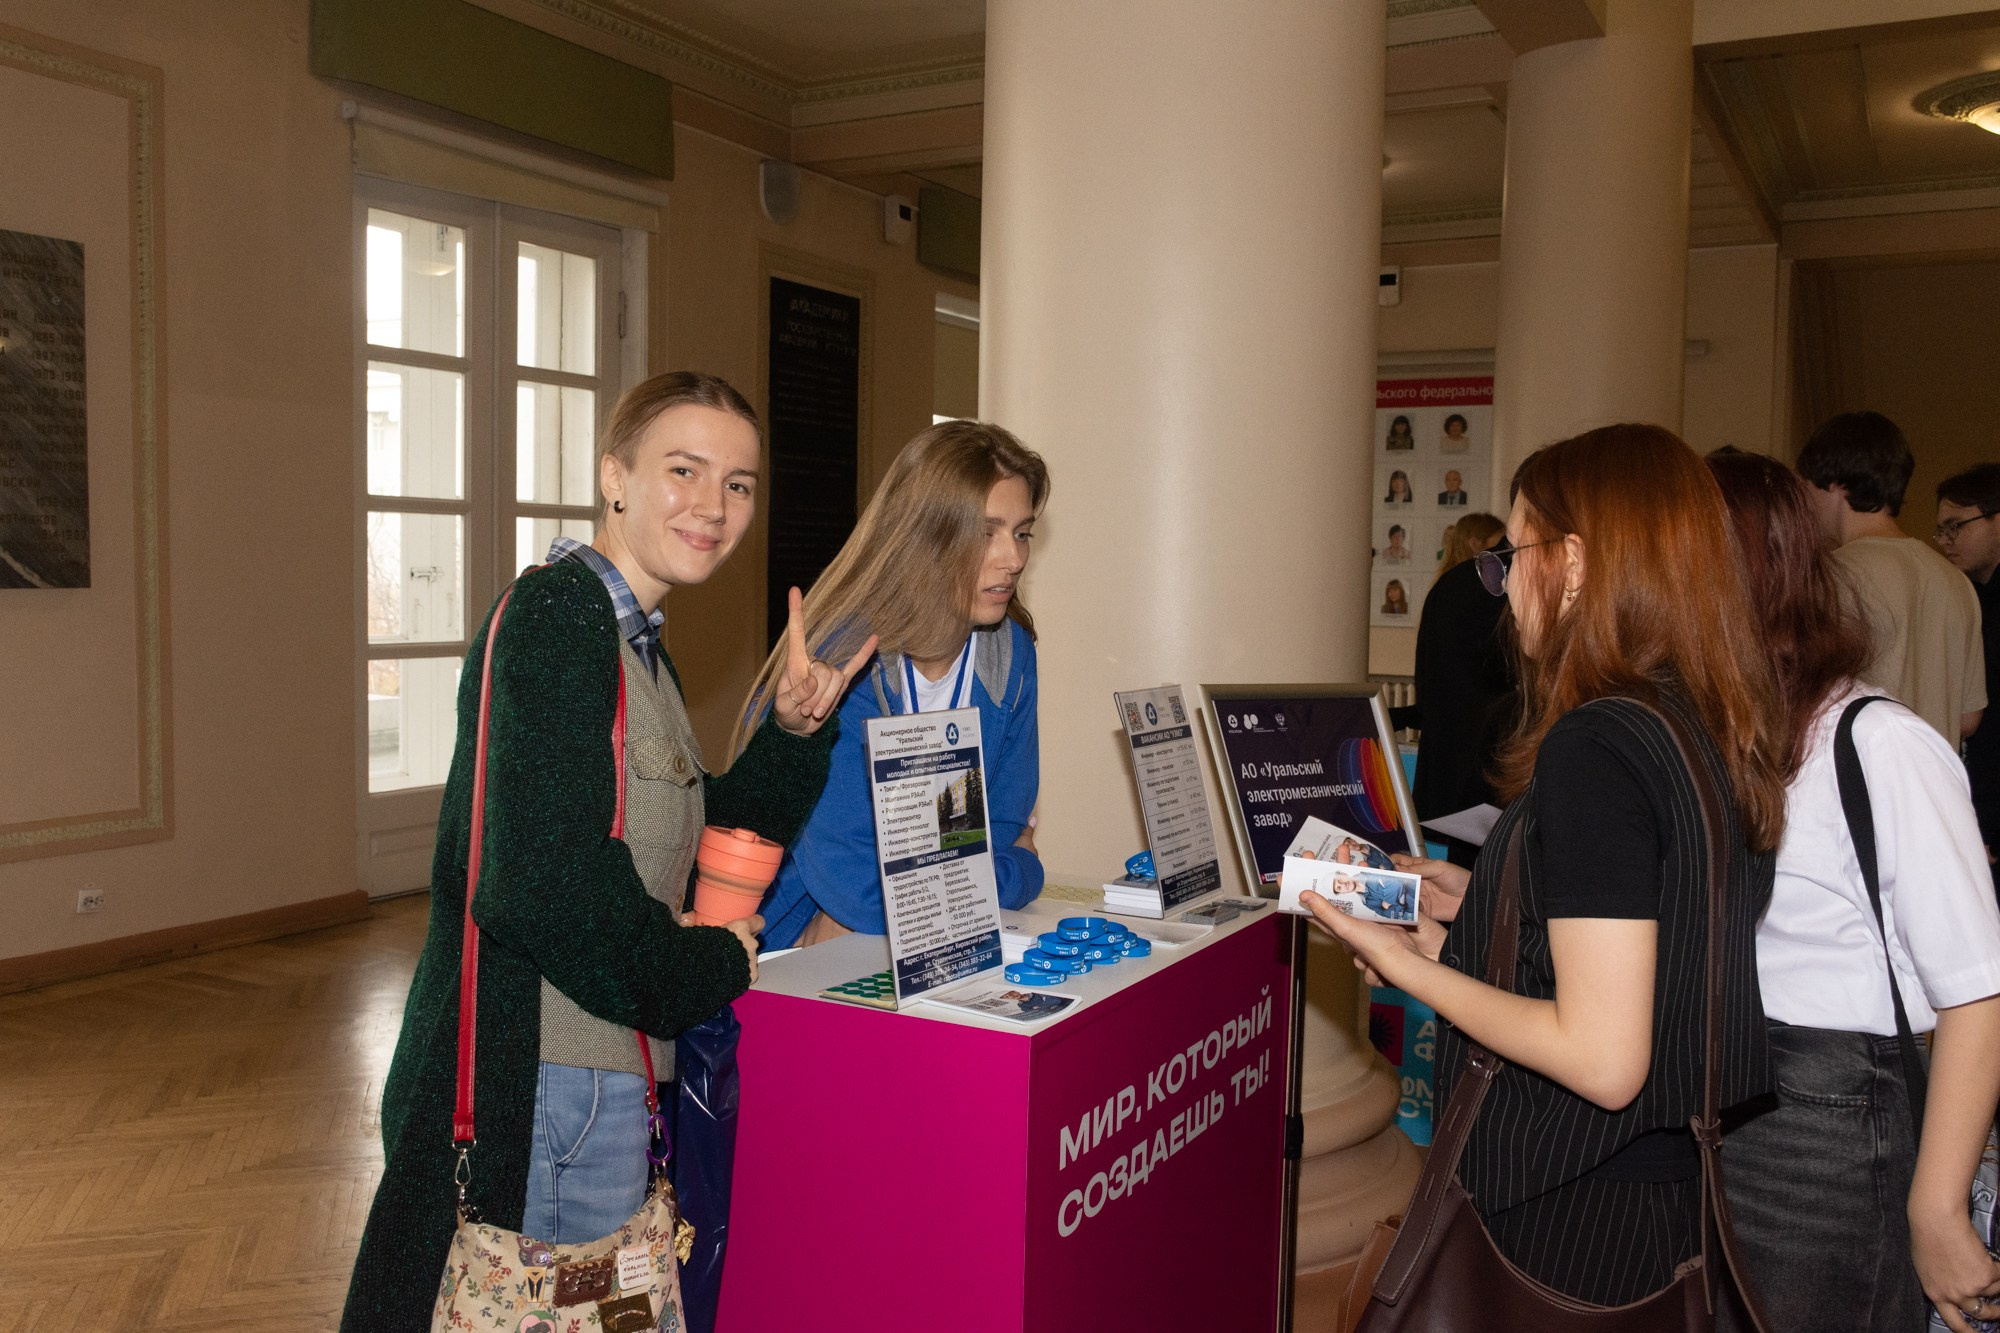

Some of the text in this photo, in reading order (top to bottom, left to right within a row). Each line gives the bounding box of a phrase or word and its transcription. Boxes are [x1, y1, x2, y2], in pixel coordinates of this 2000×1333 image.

[880, 728, 912, 736] Акционерное
[896, 735, 923, 743] "Уральский
[875, 744, 928, 756] электромеханический
[900, 756, 932, 766] Приглашаем
[939, 752, 956, 761] работу
[886, 770, 909, 778] молодых
[915, 765, 936, 773] опытных
[937, 760, 971, 769] специалистов!
[1241, 759, 1324, 781] АО «Уральский
[1246, 780, 1365, 804] электромеханический
[1253, 813, 1293, 828] завод»
[1059, 985, 1271, 1171] МИР, КОТОРЫЙ
[1057, 1048, 1270, 1238] СОЗДАЕШЬ ТЫ!
